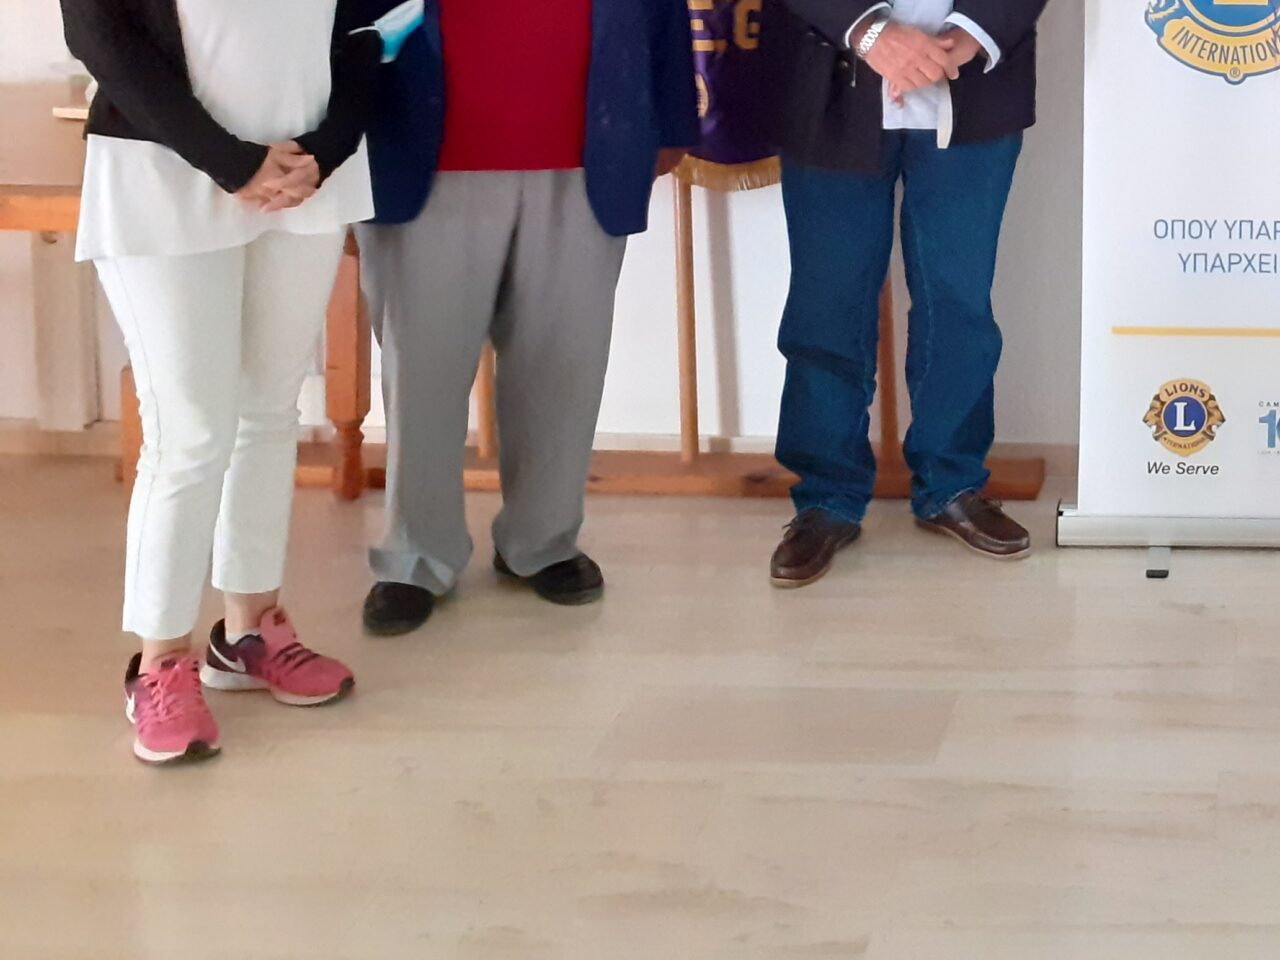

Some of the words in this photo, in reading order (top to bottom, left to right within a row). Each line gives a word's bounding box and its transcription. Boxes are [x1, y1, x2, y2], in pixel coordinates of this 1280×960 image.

[1153, 219, 1217, 240] ΟΠΟΥ
[1178, 252, 1277, 274] ΥΠΑΡΧΕΙ
[1164, 382, 1206, 399] LIONS
[1173, 401, 1196, 431] L
[1147, 461, 1171, 474] We
[1175, 461, 1220, 475] Serve
